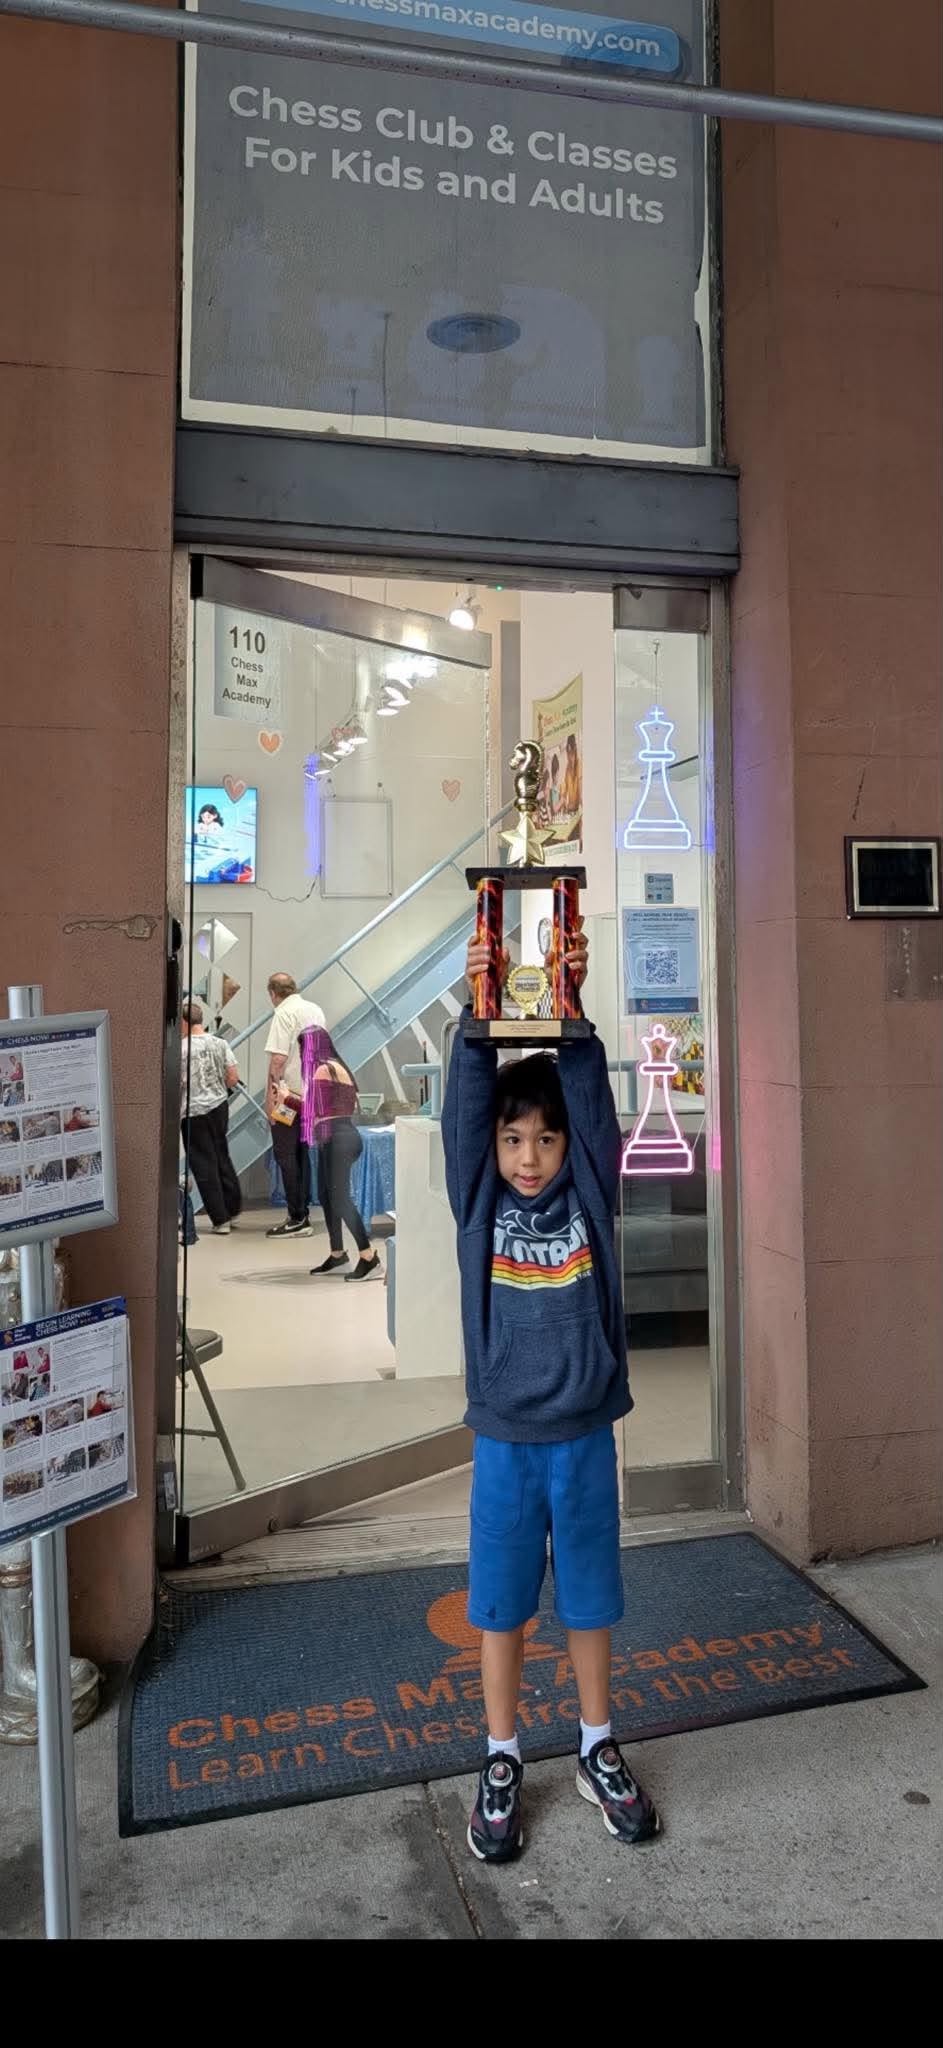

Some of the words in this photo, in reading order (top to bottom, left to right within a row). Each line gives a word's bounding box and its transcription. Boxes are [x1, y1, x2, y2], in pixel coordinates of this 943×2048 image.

[333, 0, 660, 57] essmaxacademy.com
[228, 85, 363, 133] Chess
[375, 107, 474, 149] Club
[486, 124, 515, 156] &
[527, 130, 678, 179] Classes
[245, 136, 317, 175] For
[331, 149, 425, 191] Kids
[437, 170, 516, 204] and
[528, 178, 665, 224] Adults
[229, 626, 266, 654] 110
[231, 656, 264, 673] Chess
[236, 673, 258, 688] Max
[222, 687, 271, 709] Academy
[35, 1320, 57, 1331] BEGIN
[58, 1309, 92, 1322] LEARNING
[35, 1327, 58, 1338] CHESS
[167, 1696, 378, 1748] Chess
[396, 1676, 535, 1710] Ma
[167, 1743, 328, 1793] Learn
[343, 1708, 490, 1758] Ches
[652, 1669, 742, 1702] the
[745, 1647, 858, 1687] Best
